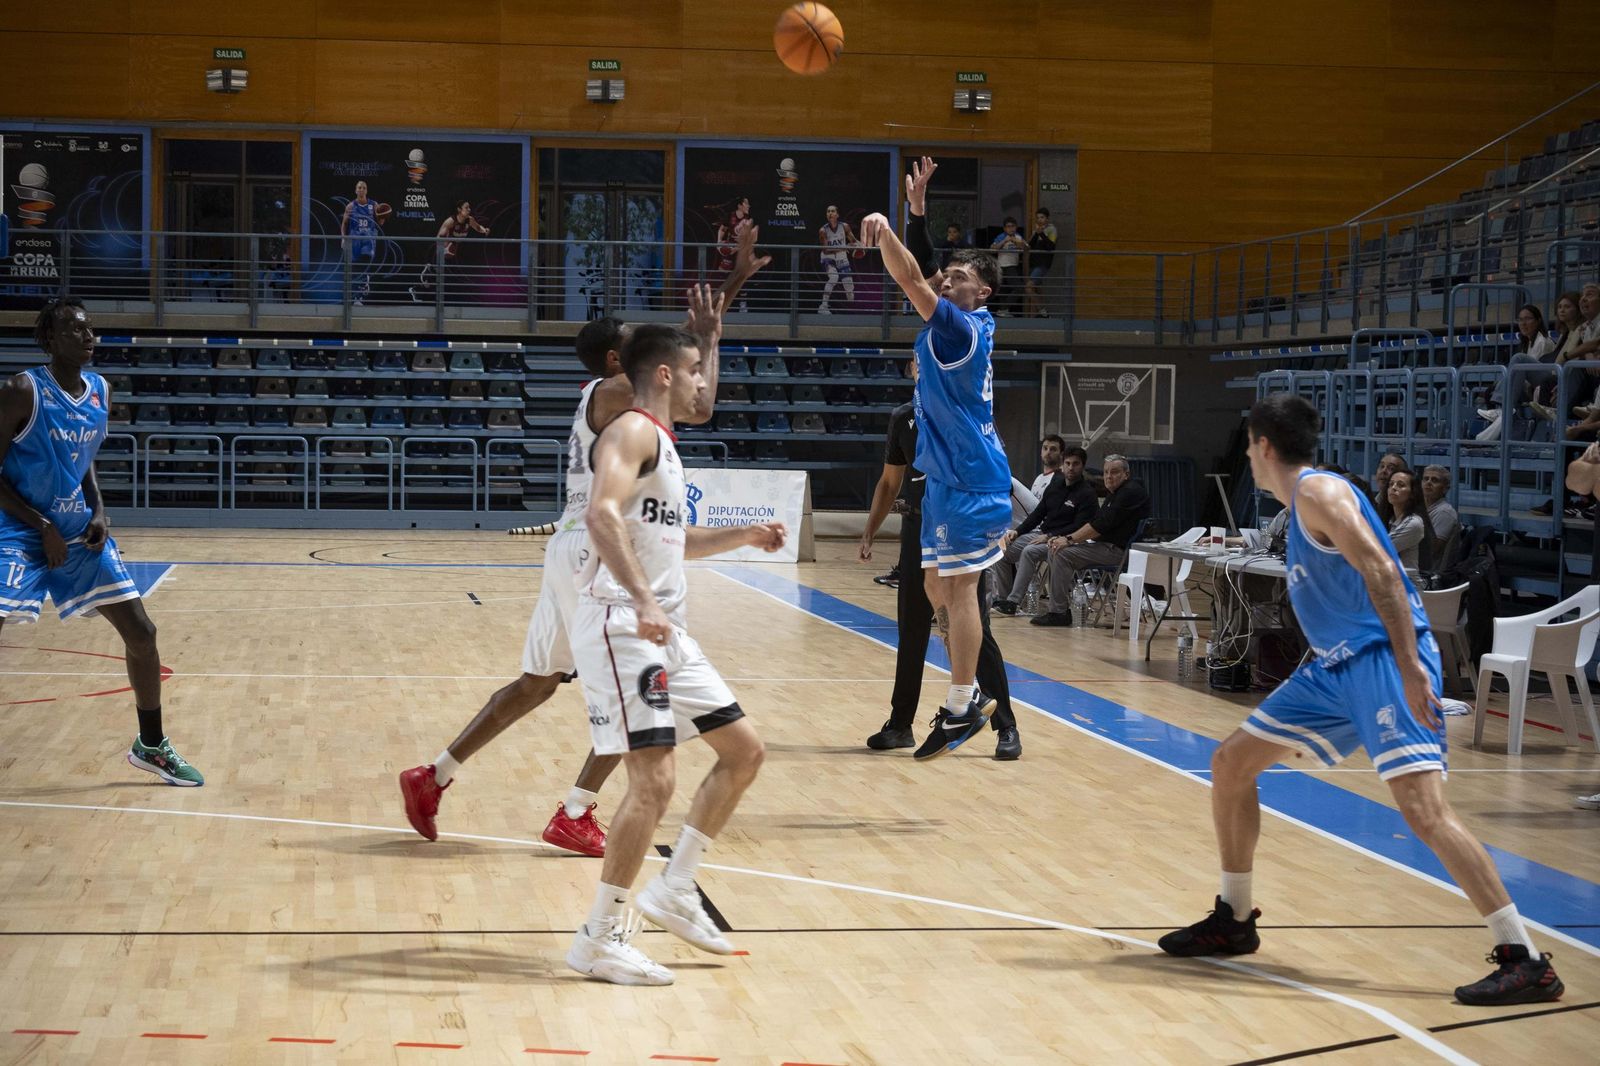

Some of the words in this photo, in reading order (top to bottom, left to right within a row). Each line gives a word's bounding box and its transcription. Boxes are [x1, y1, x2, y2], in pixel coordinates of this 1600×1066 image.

[216, 49, 243, 58] SALIDA
[591, 61, 618, 70] SALIDA
[958, 73, 984, 82] SALIDA
[405, 194, 427, 202] COPA
[776, 203, 798, 211] COPA
[15, 239, 52, 247] endesa
[13, 253, 55, 266] COPA
[19, 267, 59, 278] REINA
[708, 505, 775, 517] DIPUTACIÓN
[7, 561, 26, 589] 12
